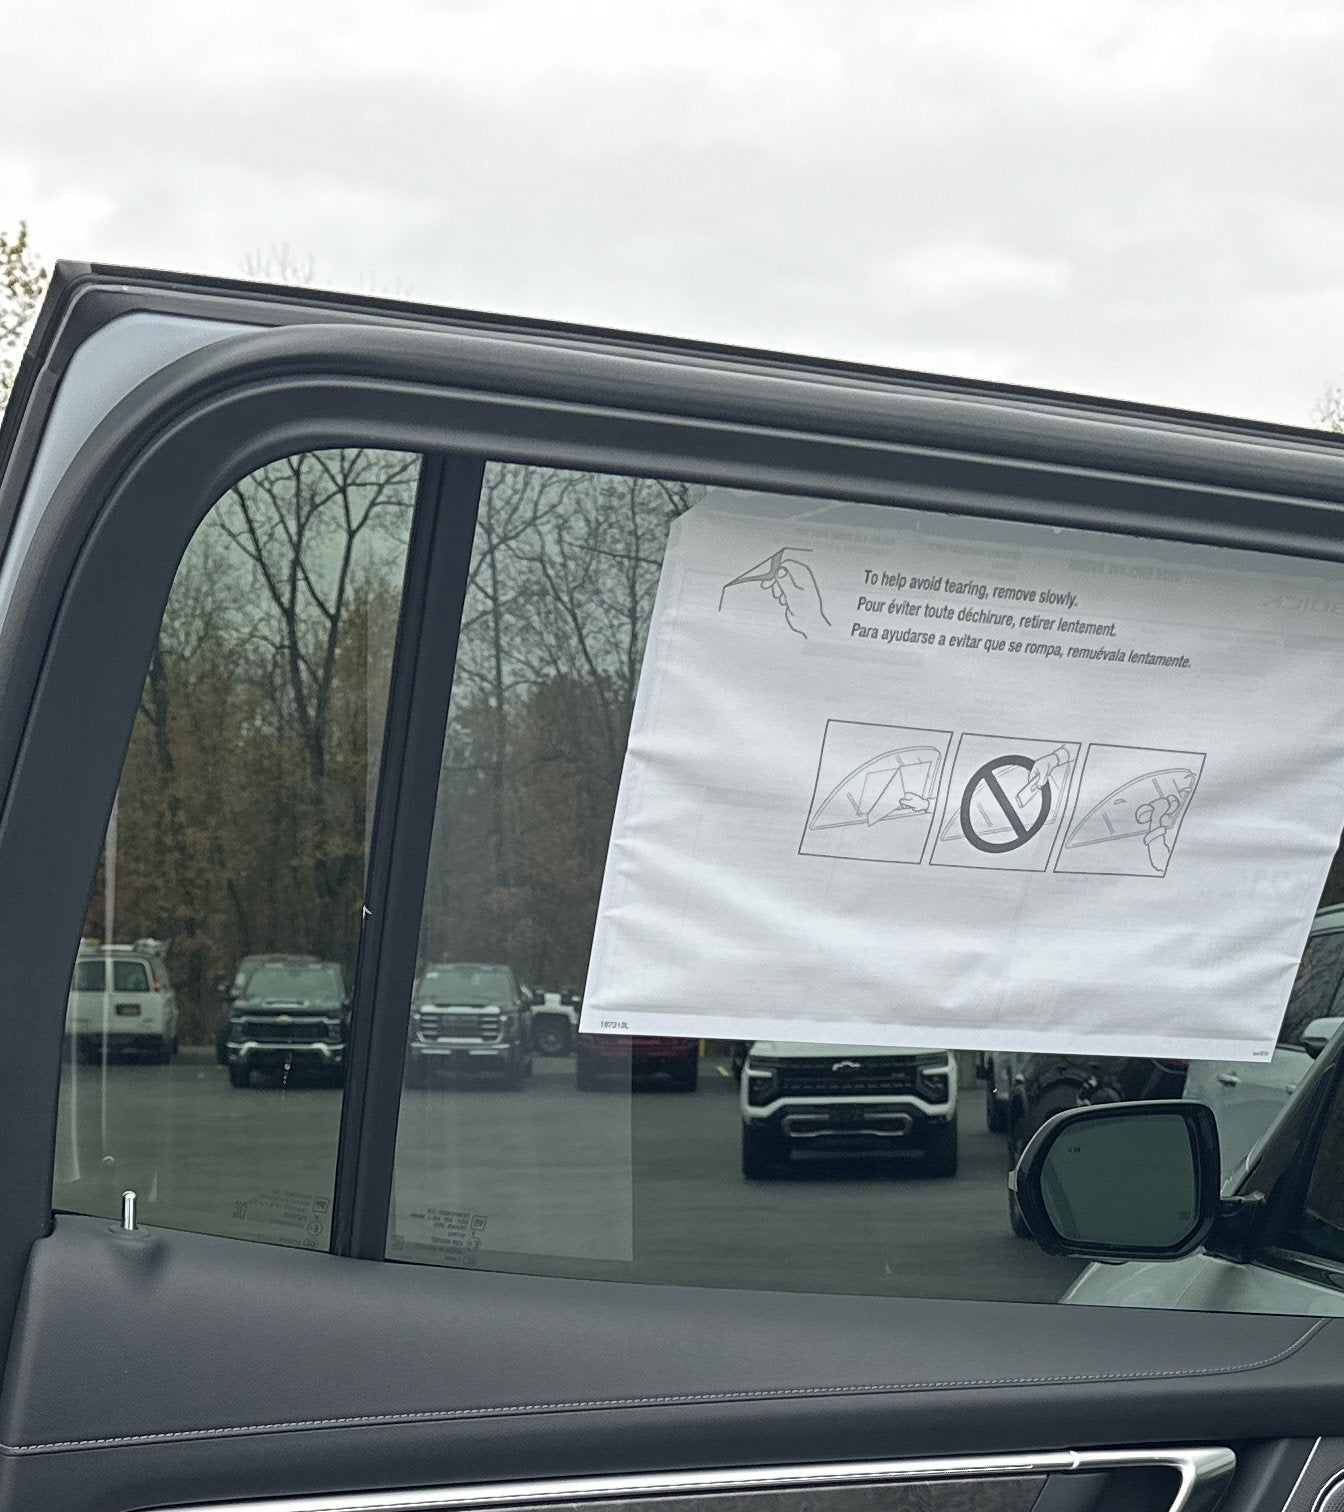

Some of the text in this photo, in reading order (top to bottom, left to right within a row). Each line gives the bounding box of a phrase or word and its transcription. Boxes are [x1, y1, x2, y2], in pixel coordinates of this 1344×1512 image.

[864, 569, 1078, 609] To help avoid tearing, remove slowly.
[857, 597, 886, 613] Pour
[888, 599, 922, 616] éviter
[924, 603, 954, 620] toute
[957, 607, 1015, 629] déchirure,
[1019, 615, 1056, 630] retirer
[851, 623, 1191, 668] Para ayudarse a evitar que se rompa, remuévala lentamente.
